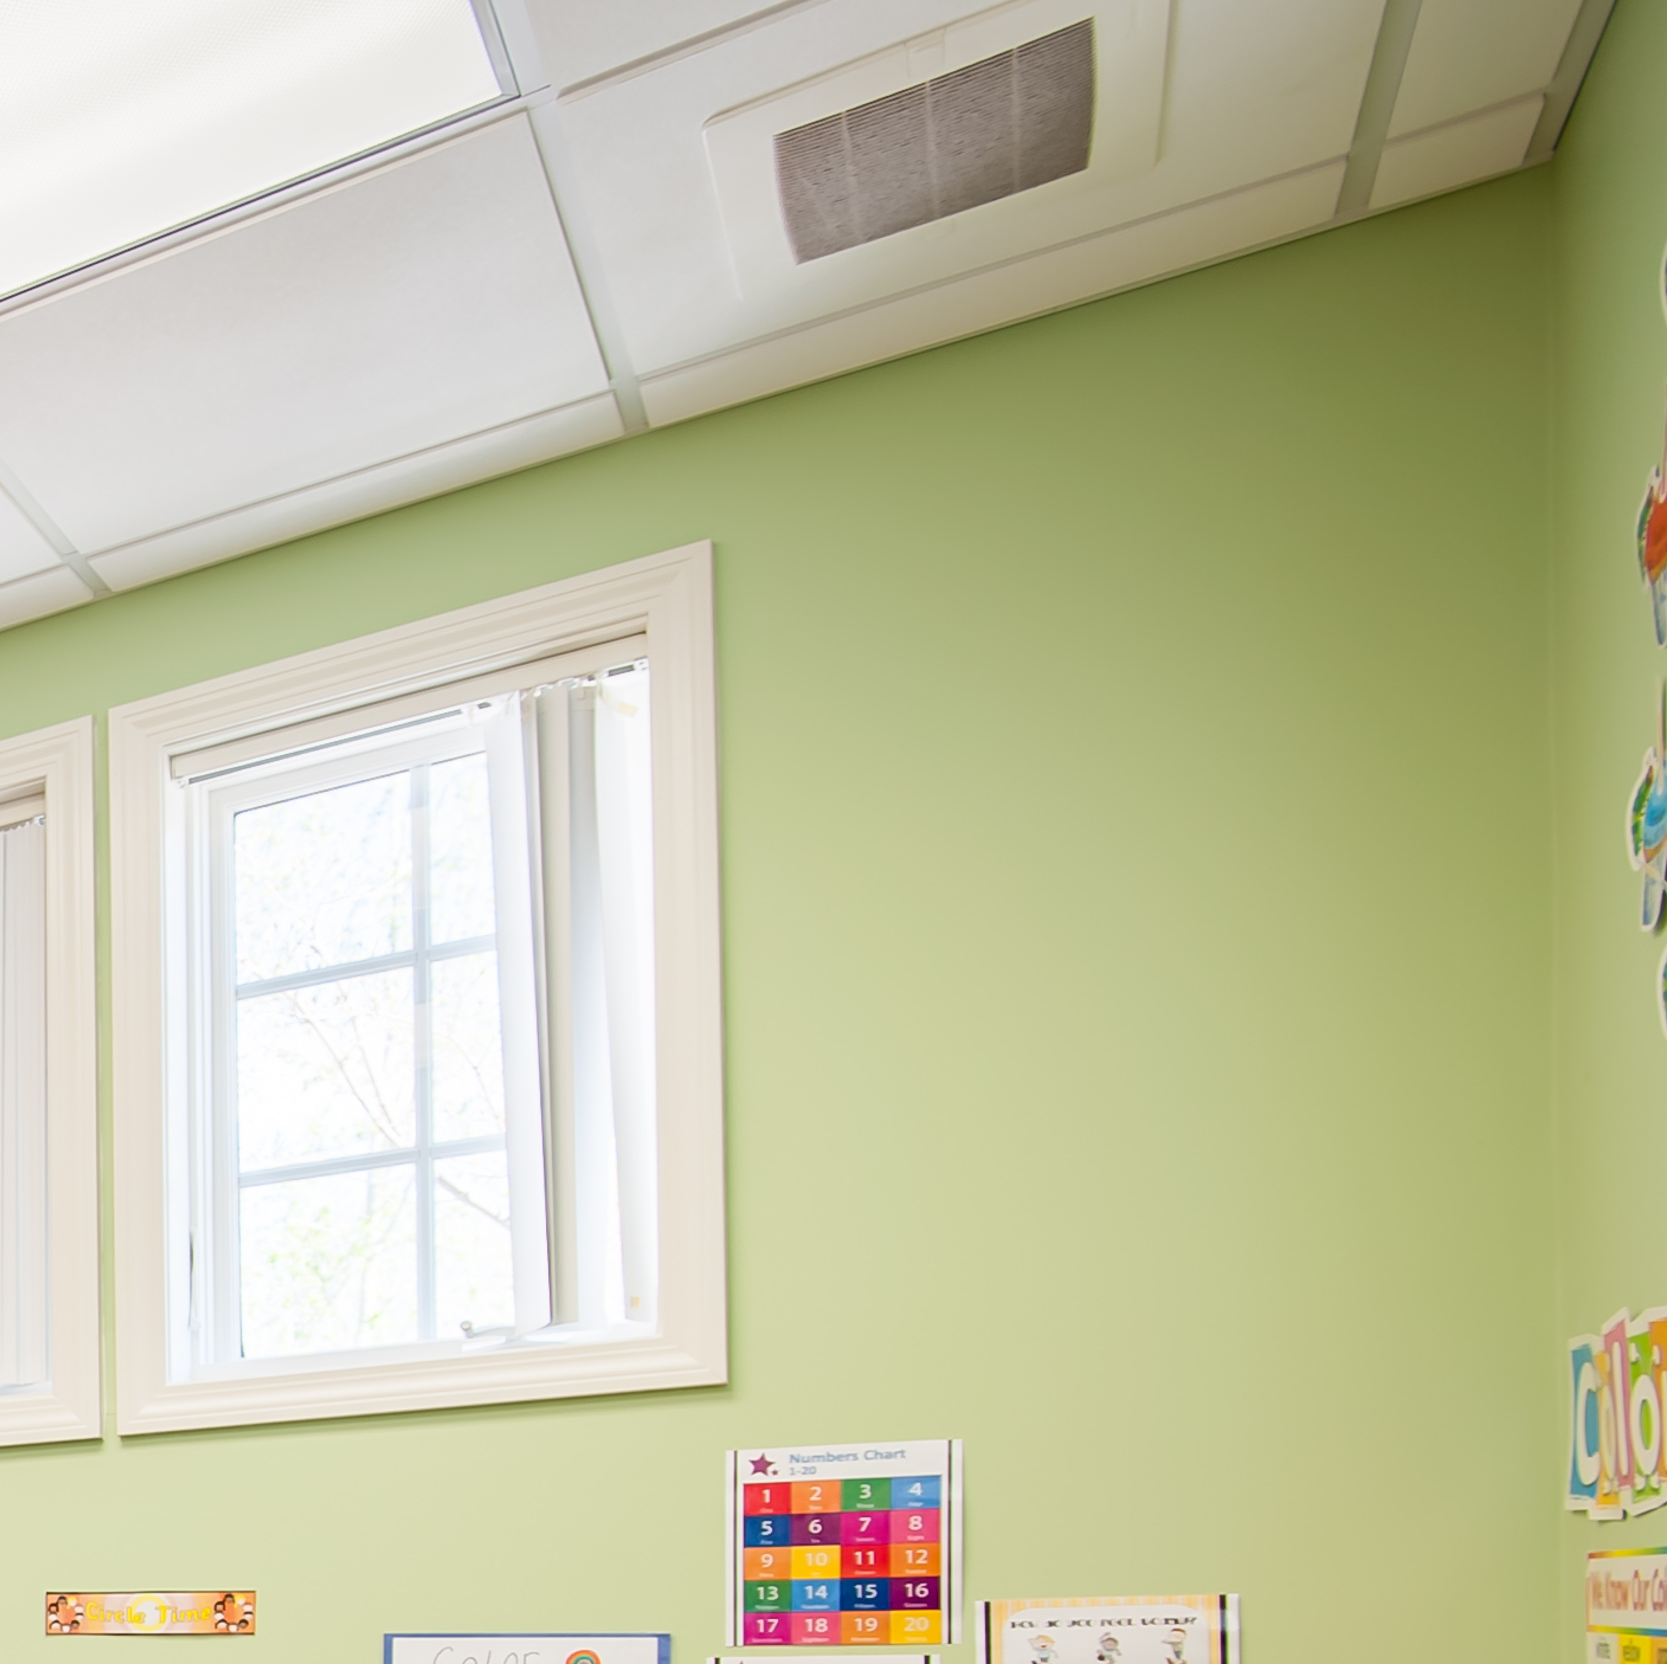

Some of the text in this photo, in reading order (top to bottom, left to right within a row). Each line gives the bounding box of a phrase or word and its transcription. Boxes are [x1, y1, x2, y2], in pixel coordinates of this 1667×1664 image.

[1576, 1340, 1667, 1488] Colo
[789, 1449, 906, 1464] Numbers Chart
[789, 1466, 817, 1476] 1-20
[762, 1490, 771, 1503] 1
[809, 1486, 822, 1501] 2
[859, 1484, 872, 1499] 3
[907, 1482, 923, 1496] 4
[761, 1520, 773, 1535] 5
[808, 1519, 823, 1534] 6
[859, 1517, 872, 1532] 7
[908, 1515, 923, 1530] 8
[761, 1553, 774, 1568] 9
[806, 1552, 828, 1567] 10
[854, 1551, 875, 1565] 11
[906, 1549, 928, 1564] 12
[757, 1586, 779, 1601] 13
[804, 1585, 828, 1599] 14
[854, 1584, 878, 1598] 15
[905, 1583, 929, 1598] 16
[86, 1602, 212, 1624] Circle Time
[757, 1618, 779, 1633] 17
[805, 1618, 829, 1632] 18
[854, 1617, 878, 1632] 19
[904, 1617, 930, 1631] 20
